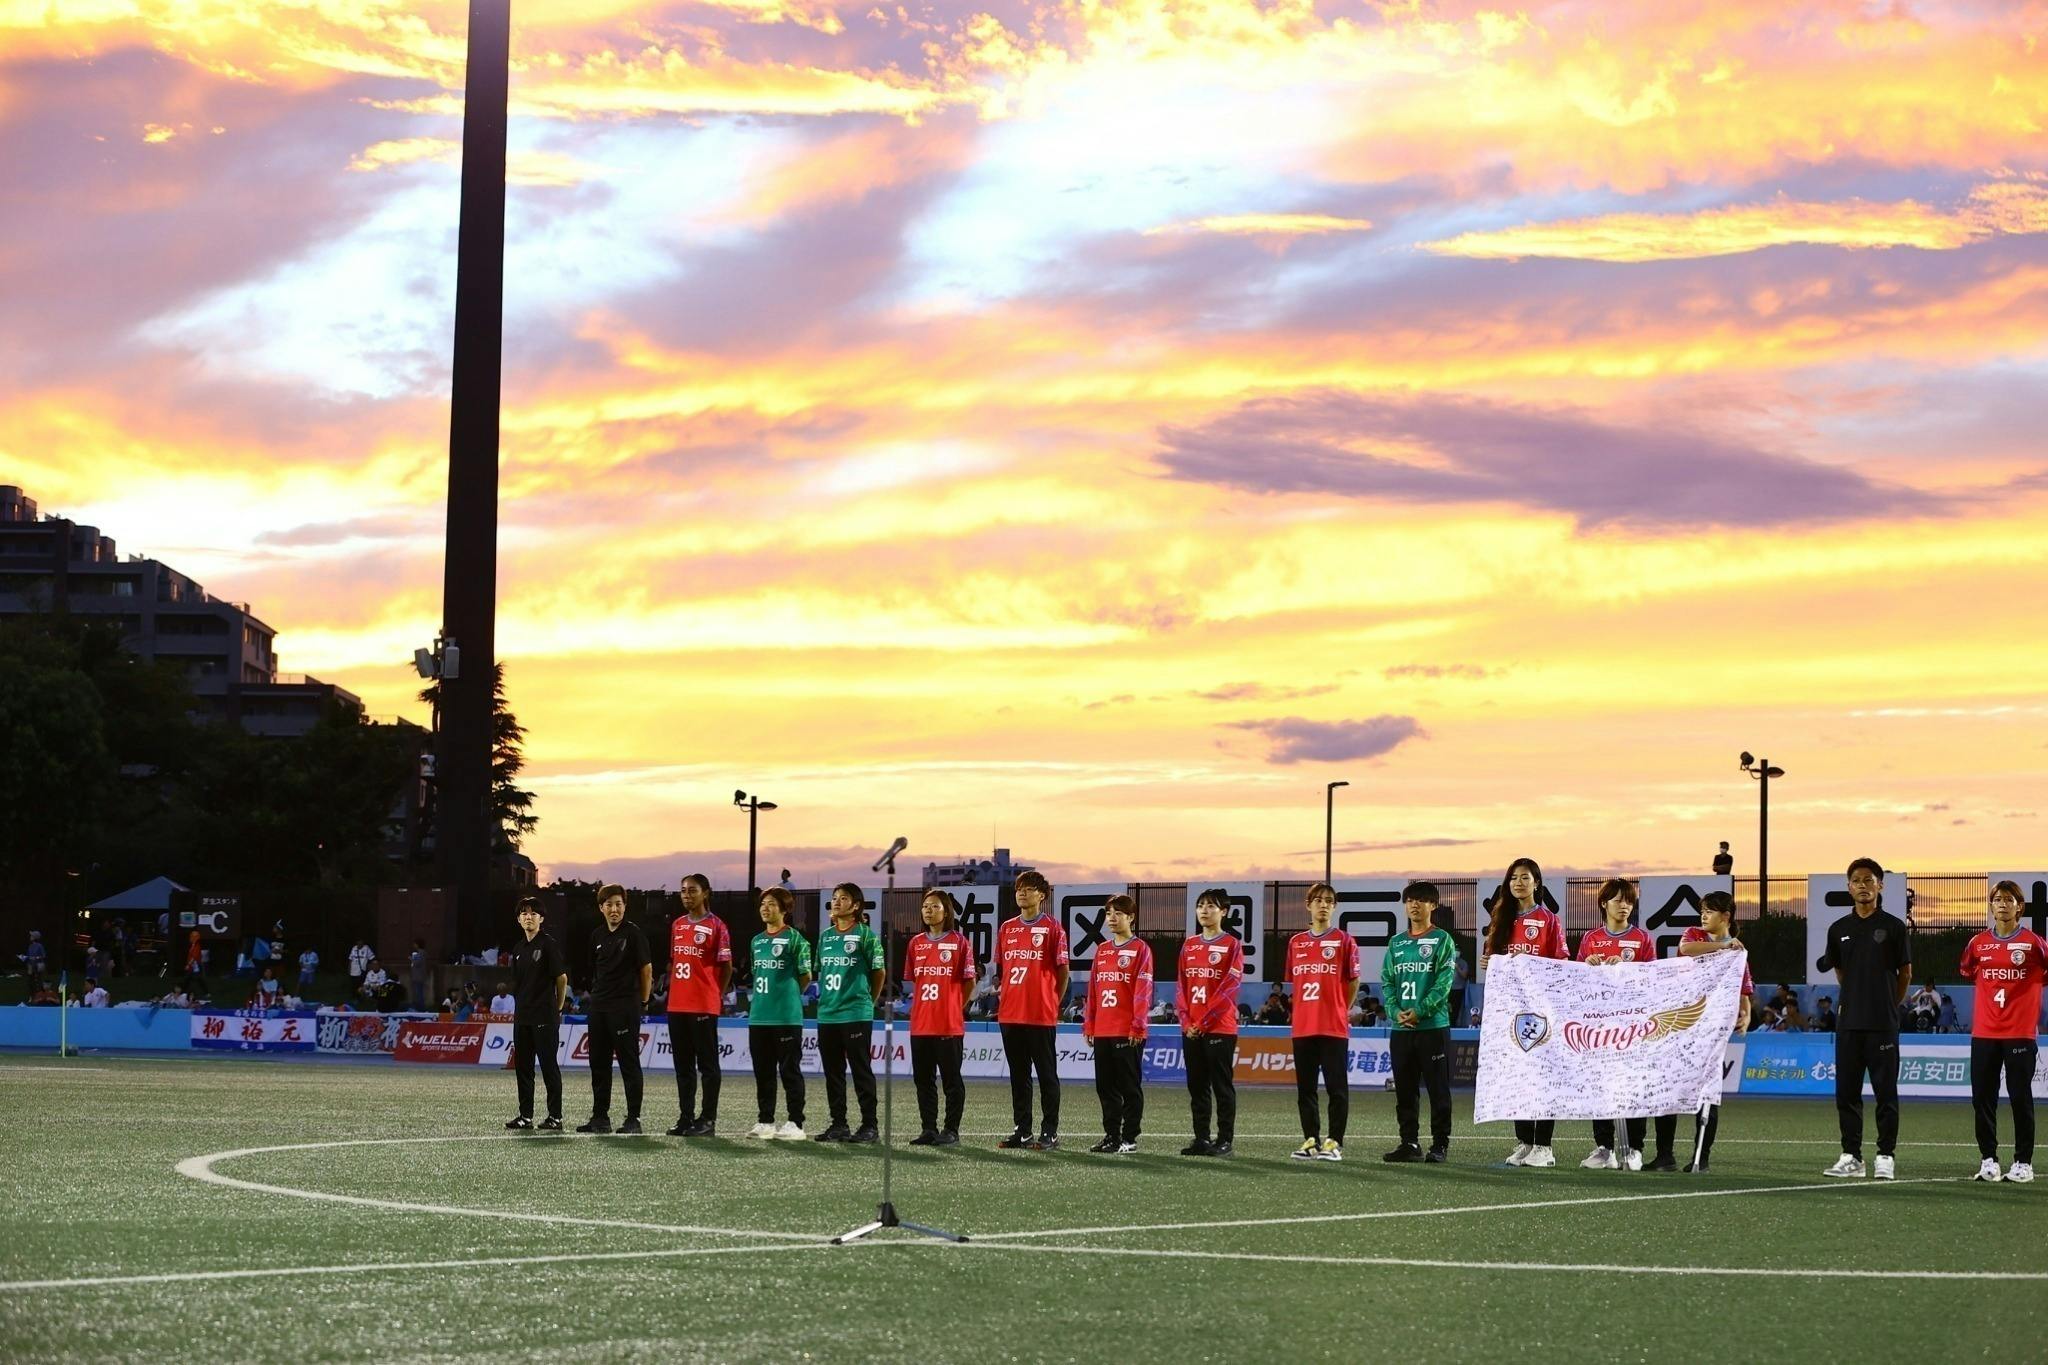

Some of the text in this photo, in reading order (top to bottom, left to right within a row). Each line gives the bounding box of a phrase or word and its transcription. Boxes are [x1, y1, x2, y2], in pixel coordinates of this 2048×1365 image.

[211, 911, 228, 933] C
[1004, 949, 1044, 960] OFFSIDE
[675, 963, 691, 979] 33
[1010, 966, 1028, 985] 27
[1292, 963, 1337, 976] OFFSIDE
[756, 977, 768, 993] 31
[825, 973, 841, 990] 30
[1401, 981, 1417, 1000] 21
[921, 983, 939, 1001] 28
[1101, 989, 1117, 1007] 25
[1191, 985, 1207, 1003] 24
[1302, 982, 1320, 1001] 22
[1993, 988, 2006, 1009] 4
[1583, 1006, 1647, 1019] NANKATSU SC
[411, 1035, 480, 1046] MUELLER
[1564, 1017, 1659, 1054] Wings
[1745, 1067, 1806, 1080] 健康ミネラル
[1898, 1061, 1965, 1082] 治安田
